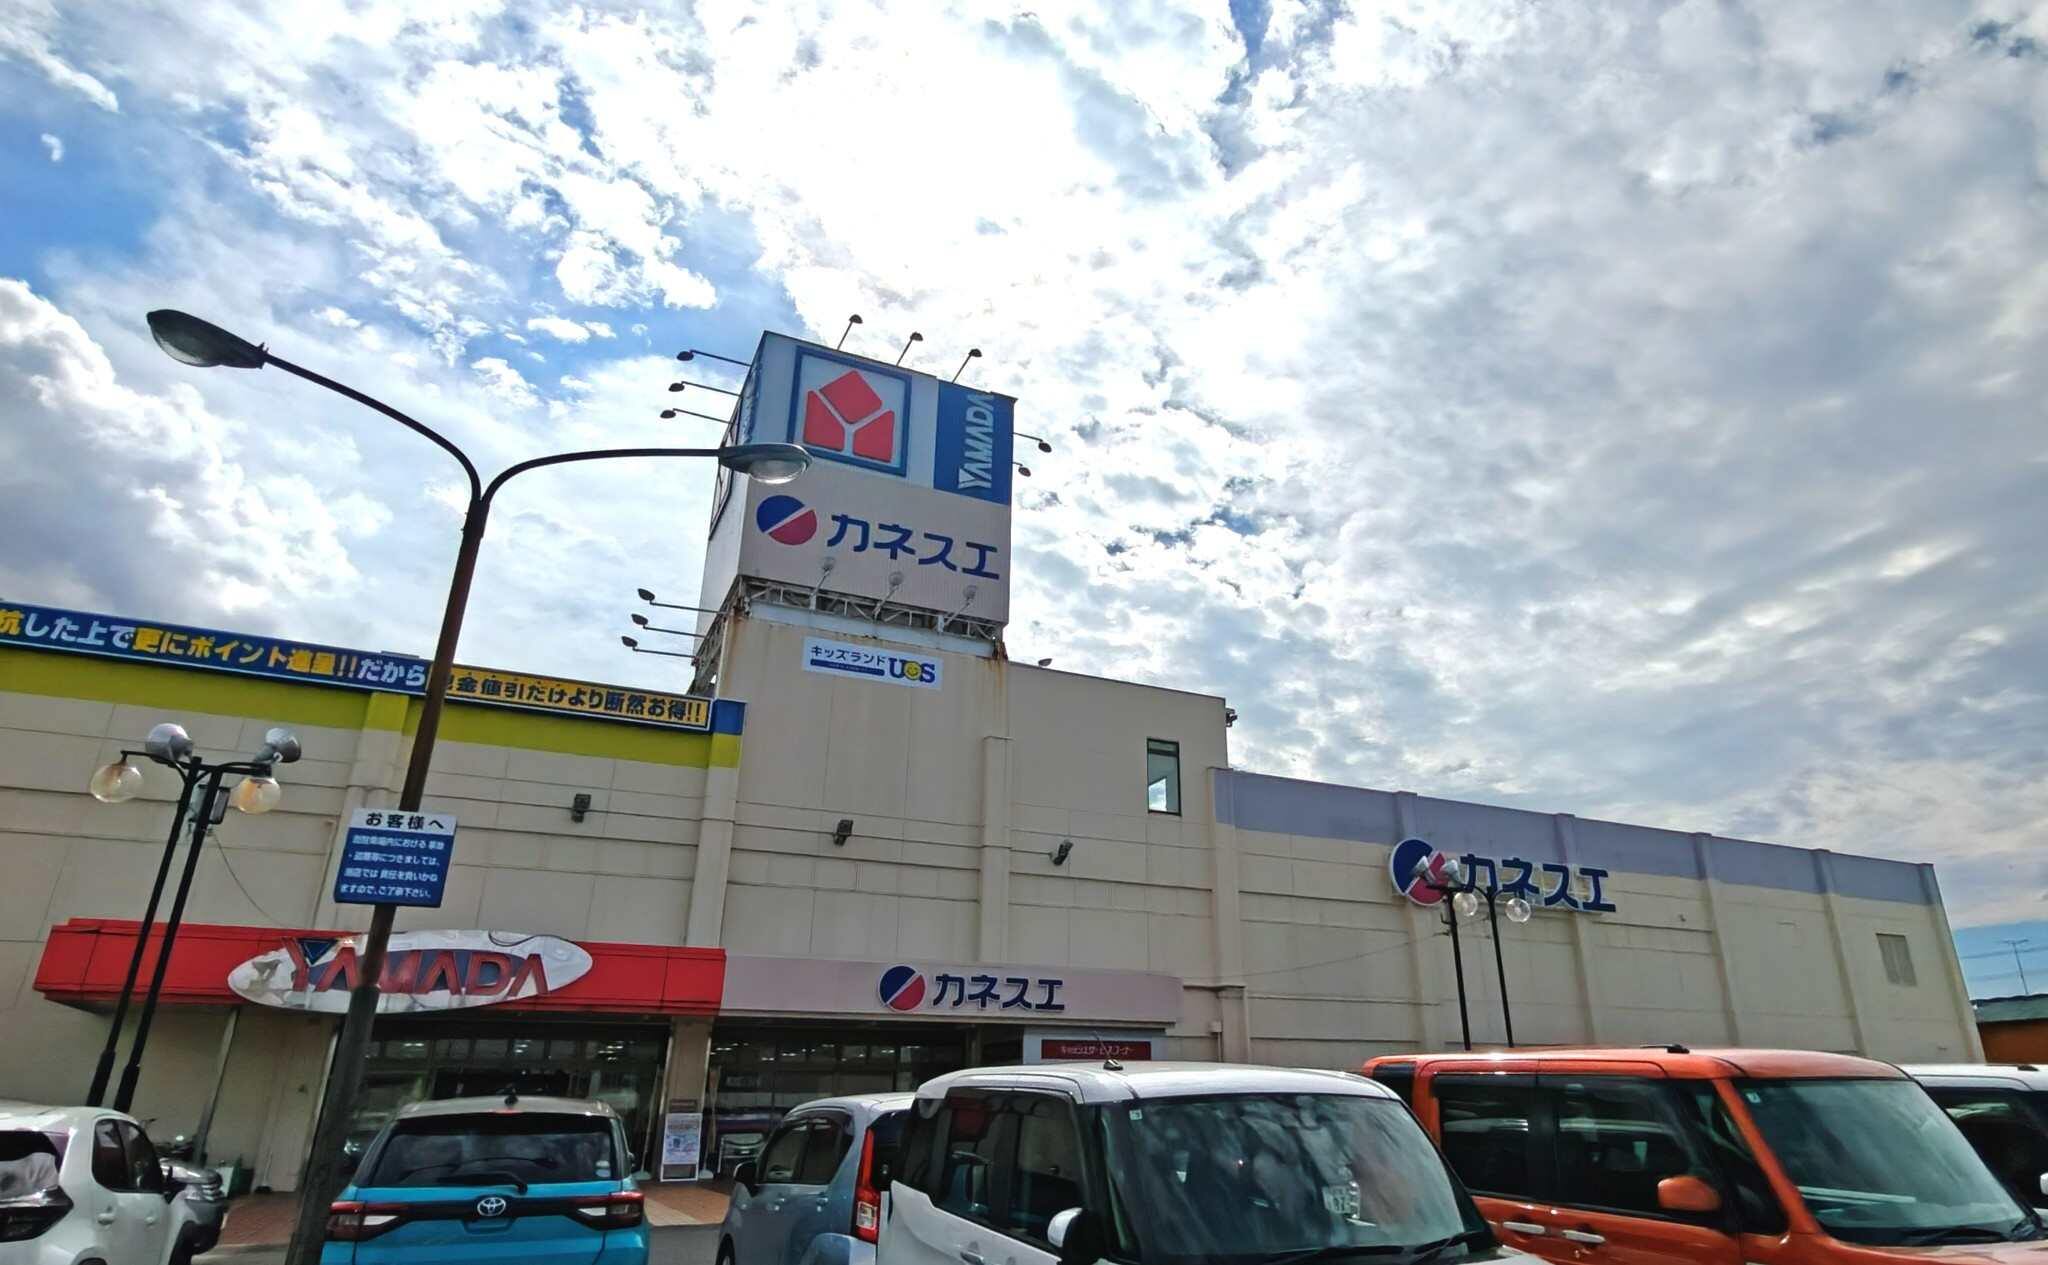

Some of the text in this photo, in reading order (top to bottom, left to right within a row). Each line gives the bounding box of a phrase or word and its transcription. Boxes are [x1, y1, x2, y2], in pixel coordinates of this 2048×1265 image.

[958, 393, 994, 489] YAMADA
[827, 513, 1000, 580] カネスエ
[811, 645, 886, 666] キッズランド
[366, 812, 445, 830] お客様へ
[1460, 853, 1617, 913] カネスエ
[932, 973, 1066, 1011] カネスエ
